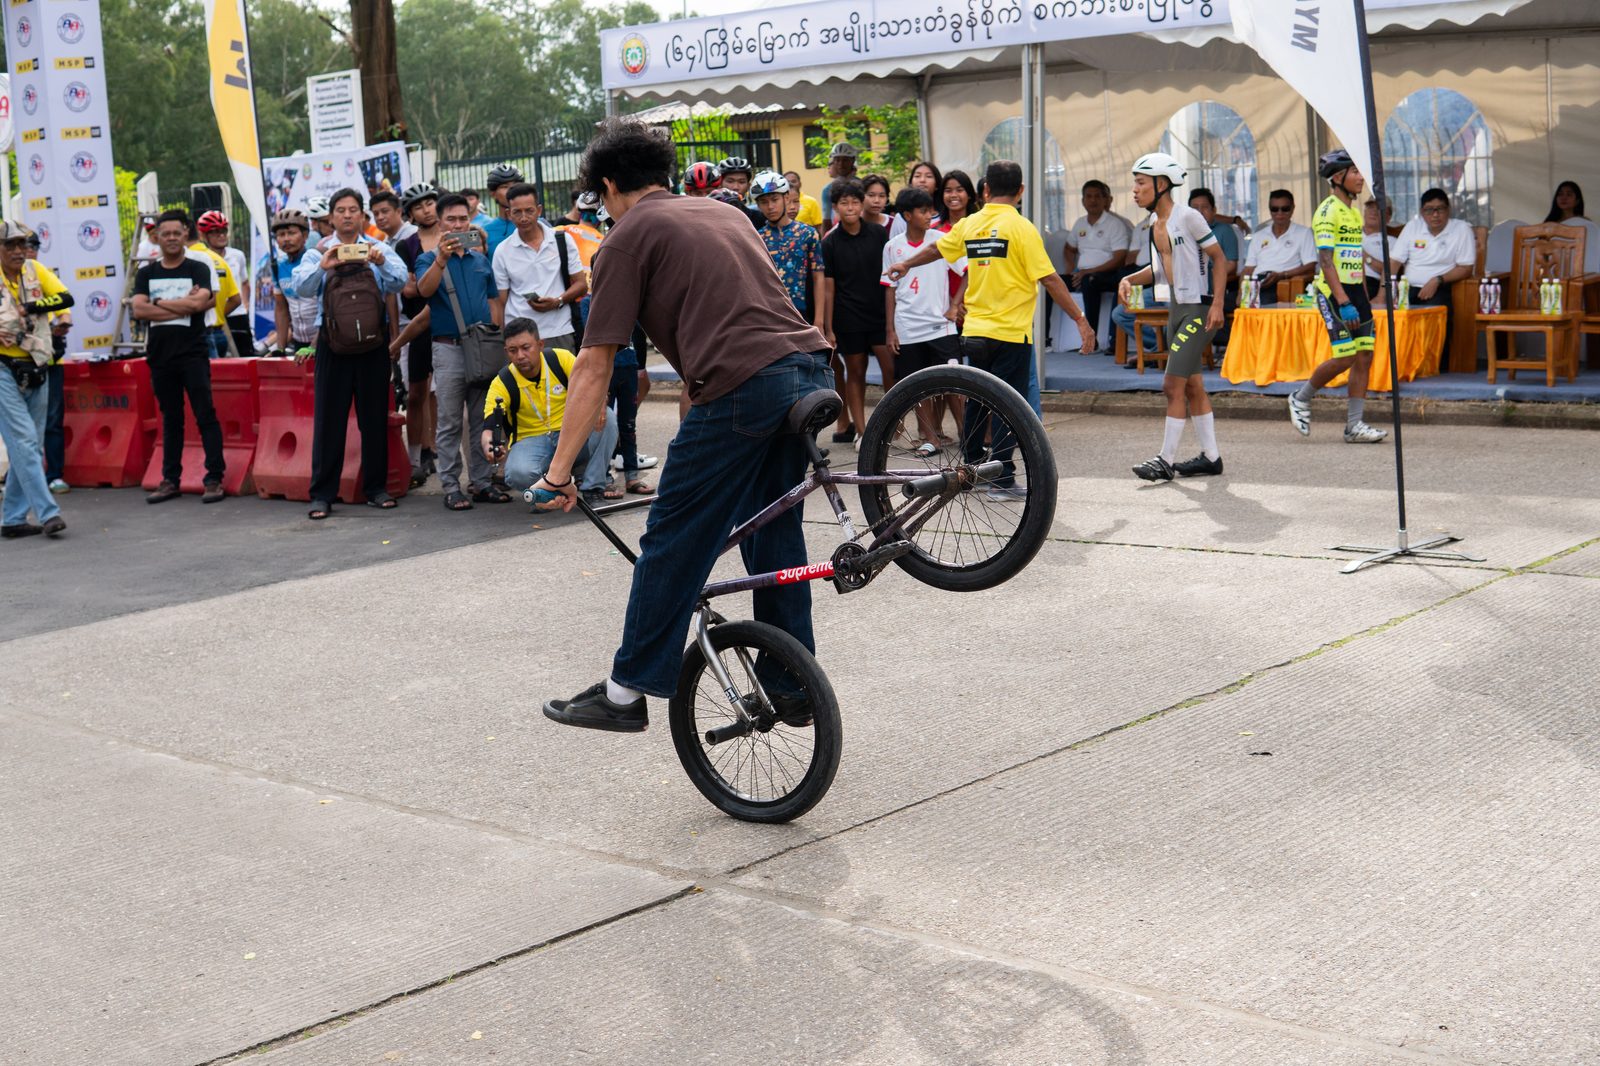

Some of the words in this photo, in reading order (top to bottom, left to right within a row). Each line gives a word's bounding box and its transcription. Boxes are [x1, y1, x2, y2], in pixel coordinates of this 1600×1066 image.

[1290, 0, 1321, 53] YM
[65, 129, 87, 137] MSP
[72, 198, 94, 206] MSP
[79, 268, 102, 277] MSP
[909, 276, 920, 295] 4
[87, 337, 109, 347] MSP
